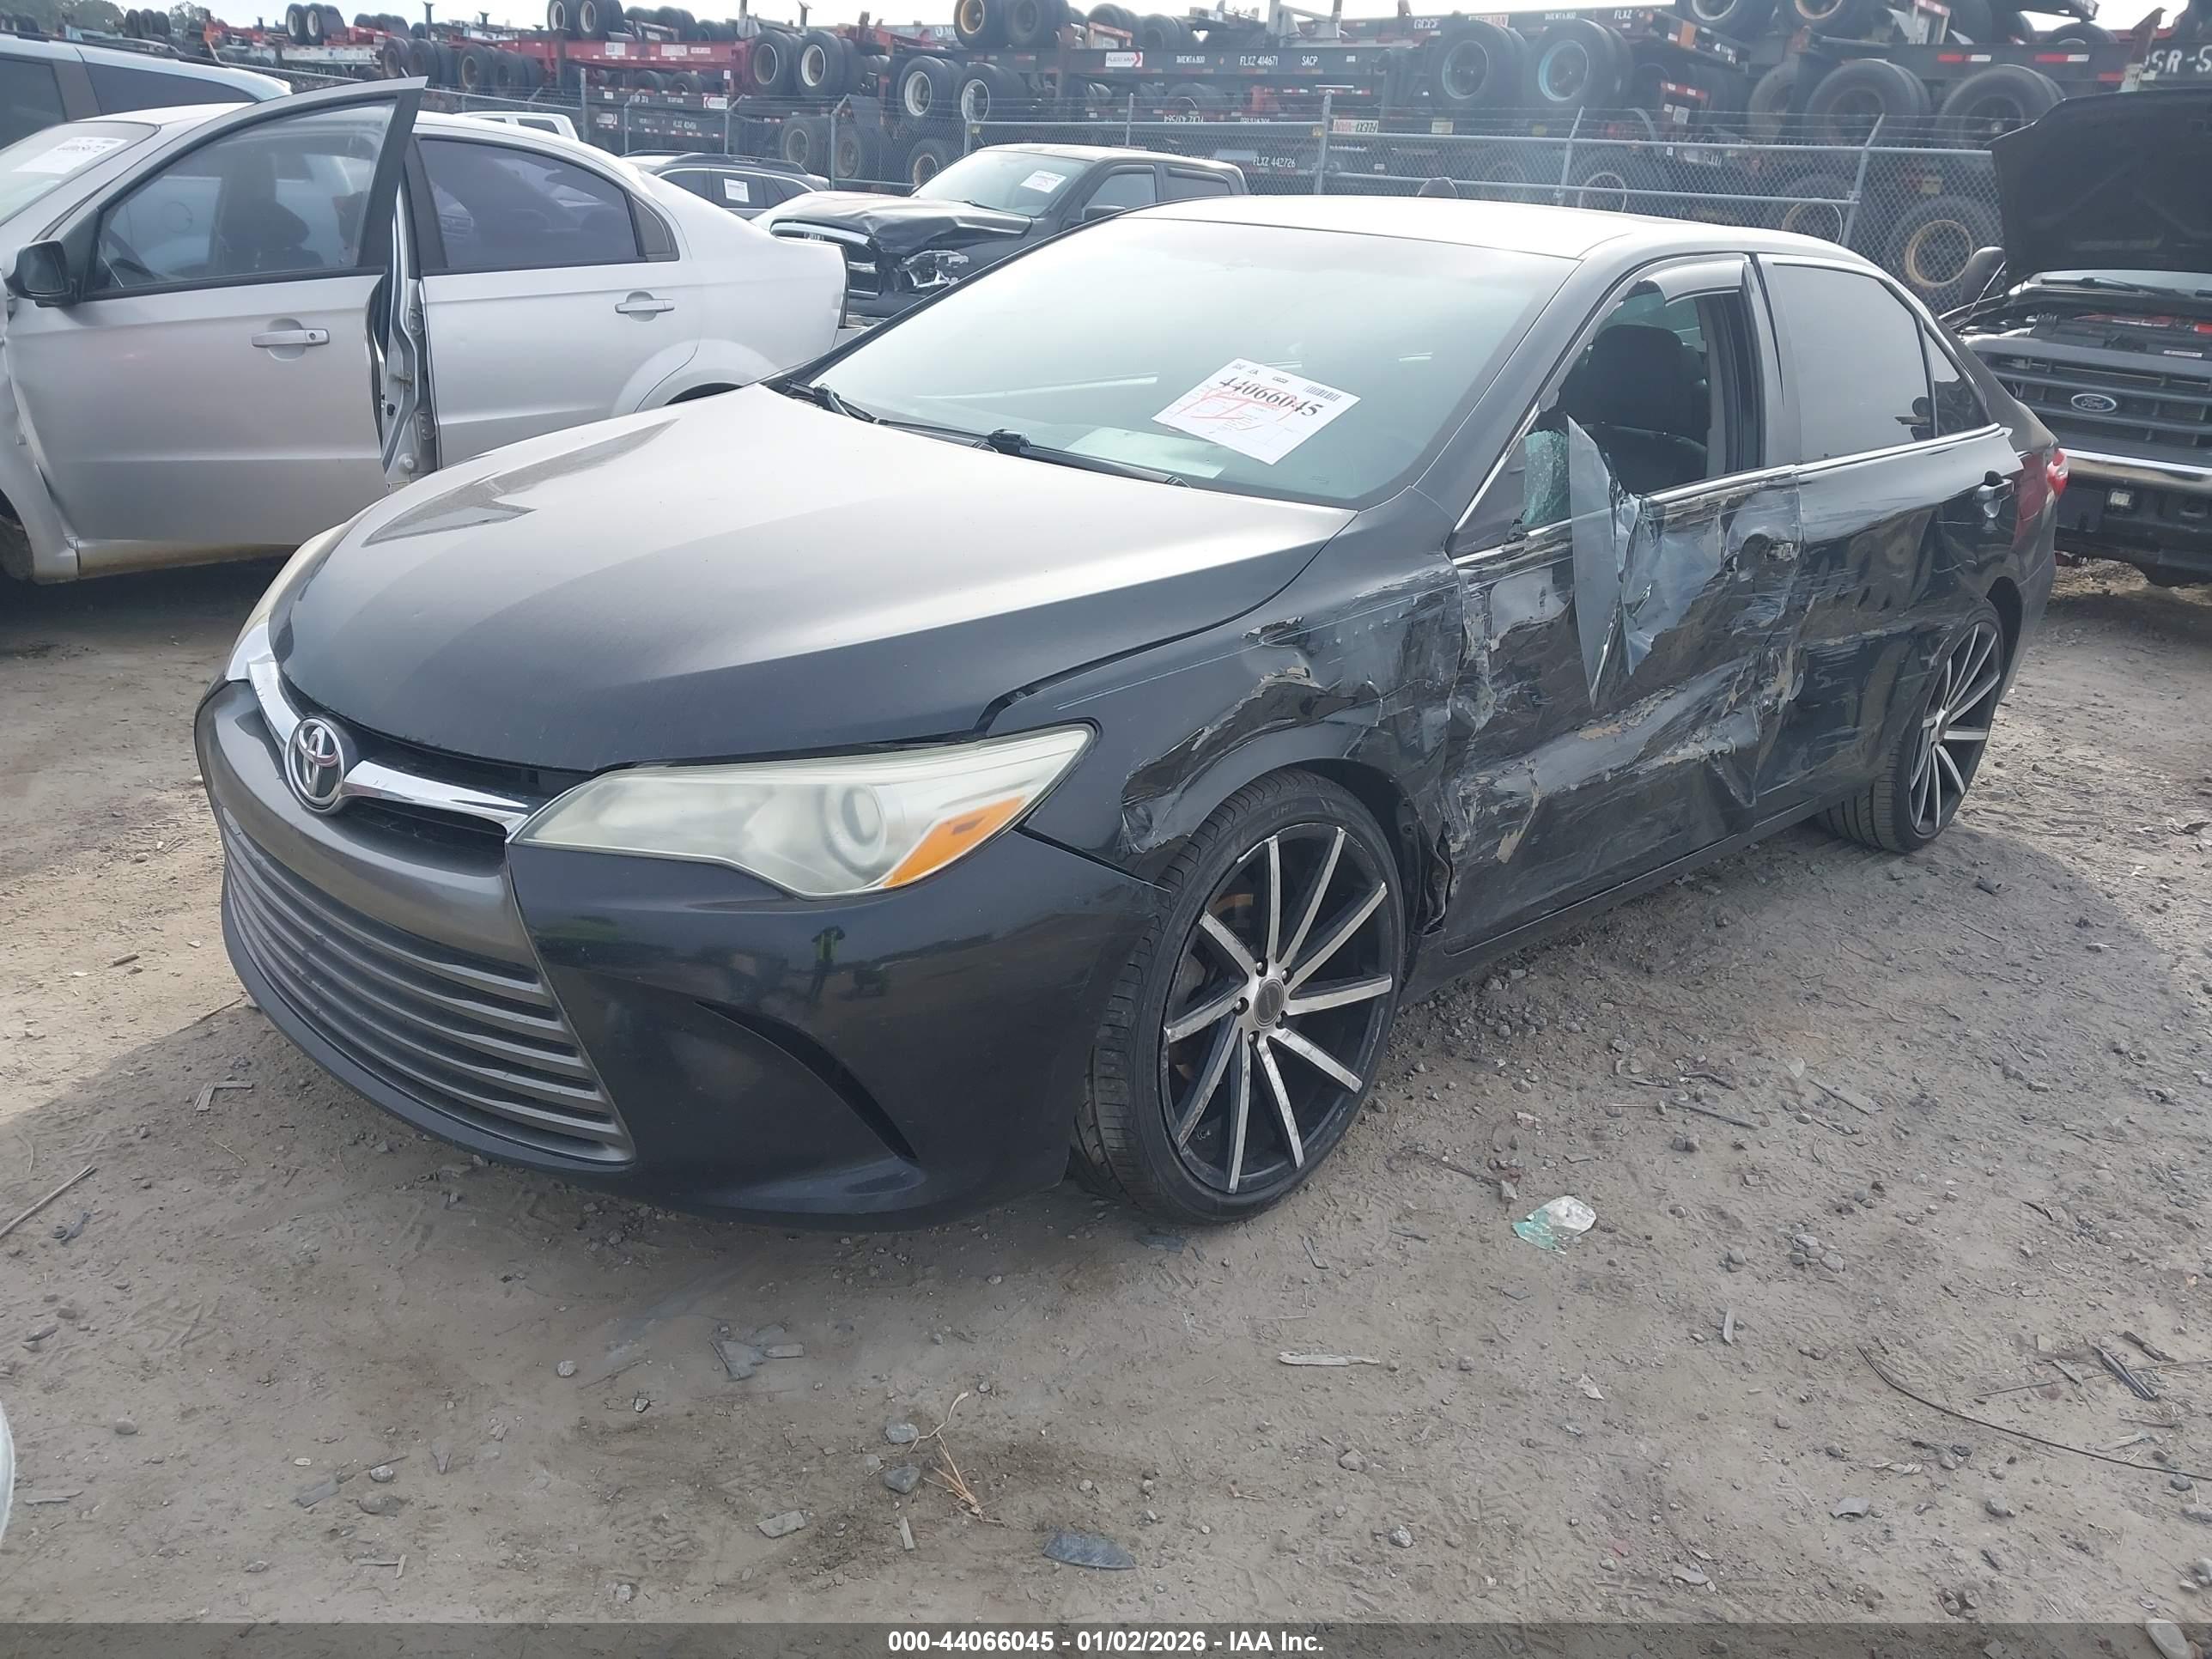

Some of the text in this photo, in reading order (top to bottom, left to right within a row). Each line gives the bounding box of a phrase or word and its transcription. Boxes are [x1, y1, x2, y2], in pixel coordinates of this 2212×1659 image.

[1239, 55, 1256, 66] FLXZ
[1301, 55, 1318, 67] SACP
[1219, 376, 1325, 417] 44066045
